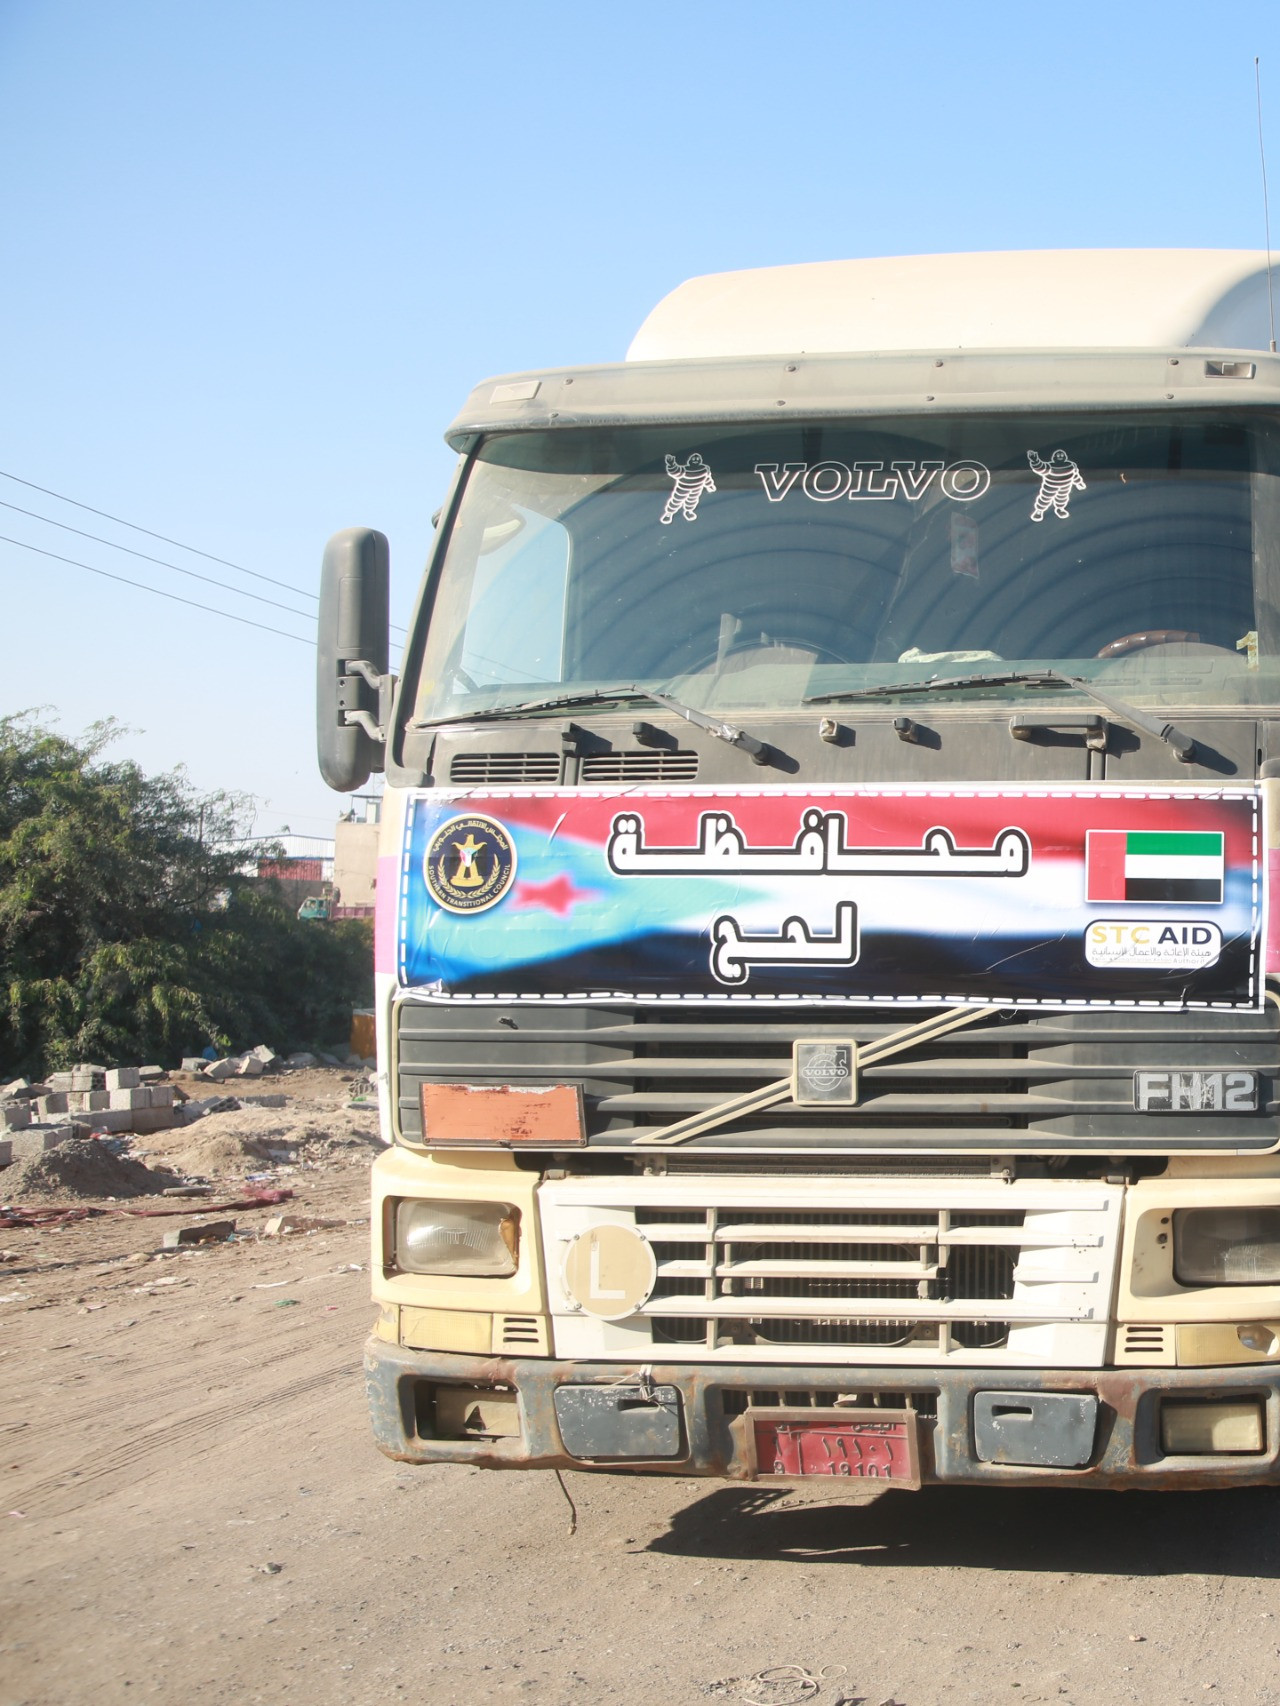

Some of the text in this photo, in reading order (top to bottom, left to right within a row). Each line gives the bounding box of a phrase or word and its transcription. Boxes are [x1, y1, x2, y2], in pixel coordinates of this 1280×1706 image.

[755, 460, 990, 501] VOLVO
[1236, 631, 1258, 671] 1
[608, 809, 1032, 878] محافظة
[429, 864, 511, 907] SOUTHERN TRANSITIONAL COUNCIL
[709, 900, 860, 985] لحج
[1092, 925, 1213, 945] STC AID
[804, 1068, 846, 1076] VOLVO
[1139, 1072, 1255, 1111] FH12
[589, 1240, 626, 1299] L
[826, 1461, 892, 1478] 19101
